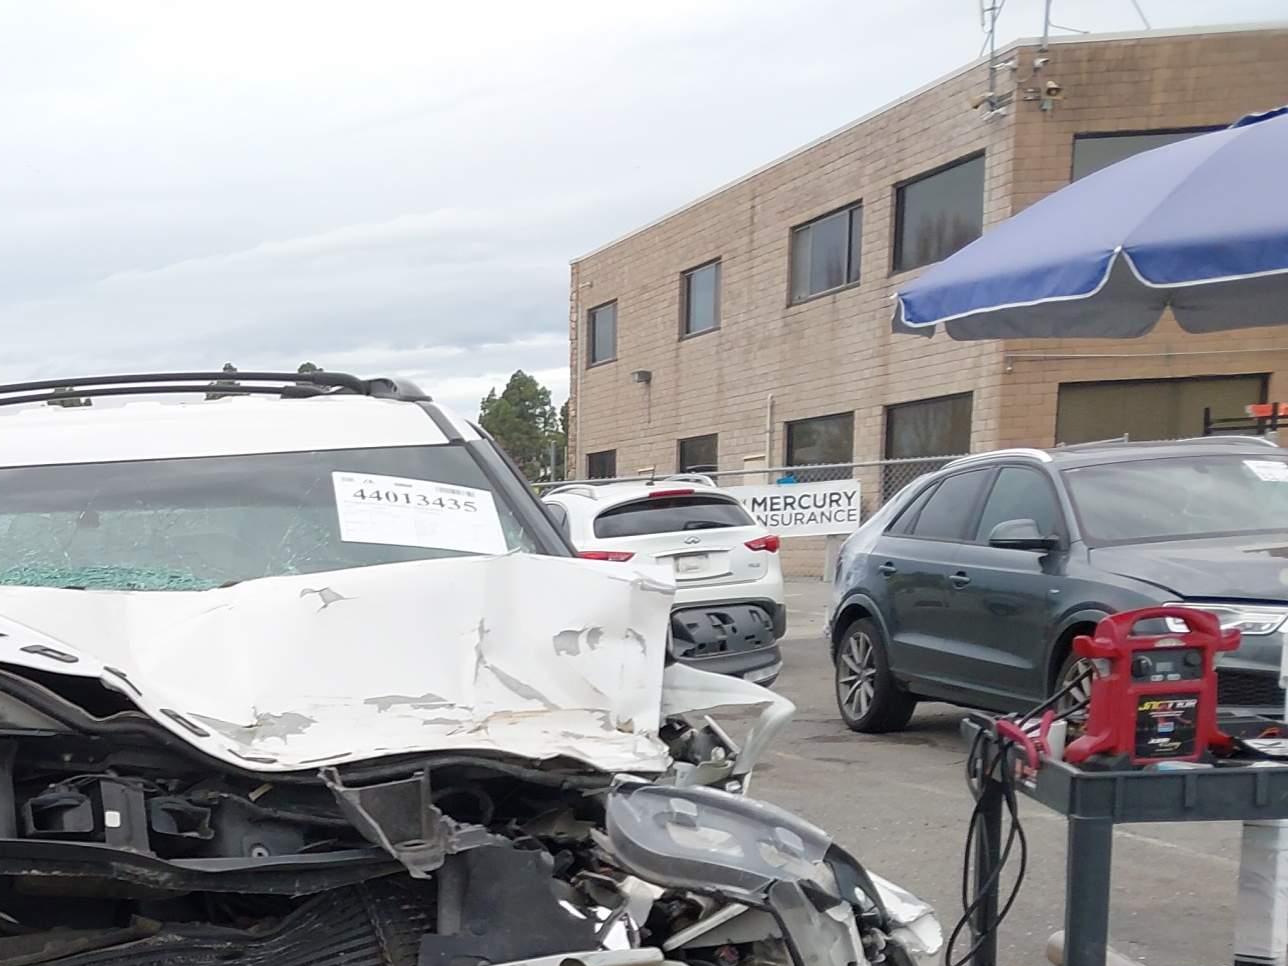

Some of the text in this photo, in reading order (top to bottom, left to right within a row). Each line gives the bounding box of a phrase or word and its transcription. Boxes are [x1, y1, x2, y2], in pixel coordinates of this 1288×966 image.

[353, 488, 478, 513] 44013435
[751, 490, 857, 513] MERCURY
[756, 508, 857, 527] NSURANCE
